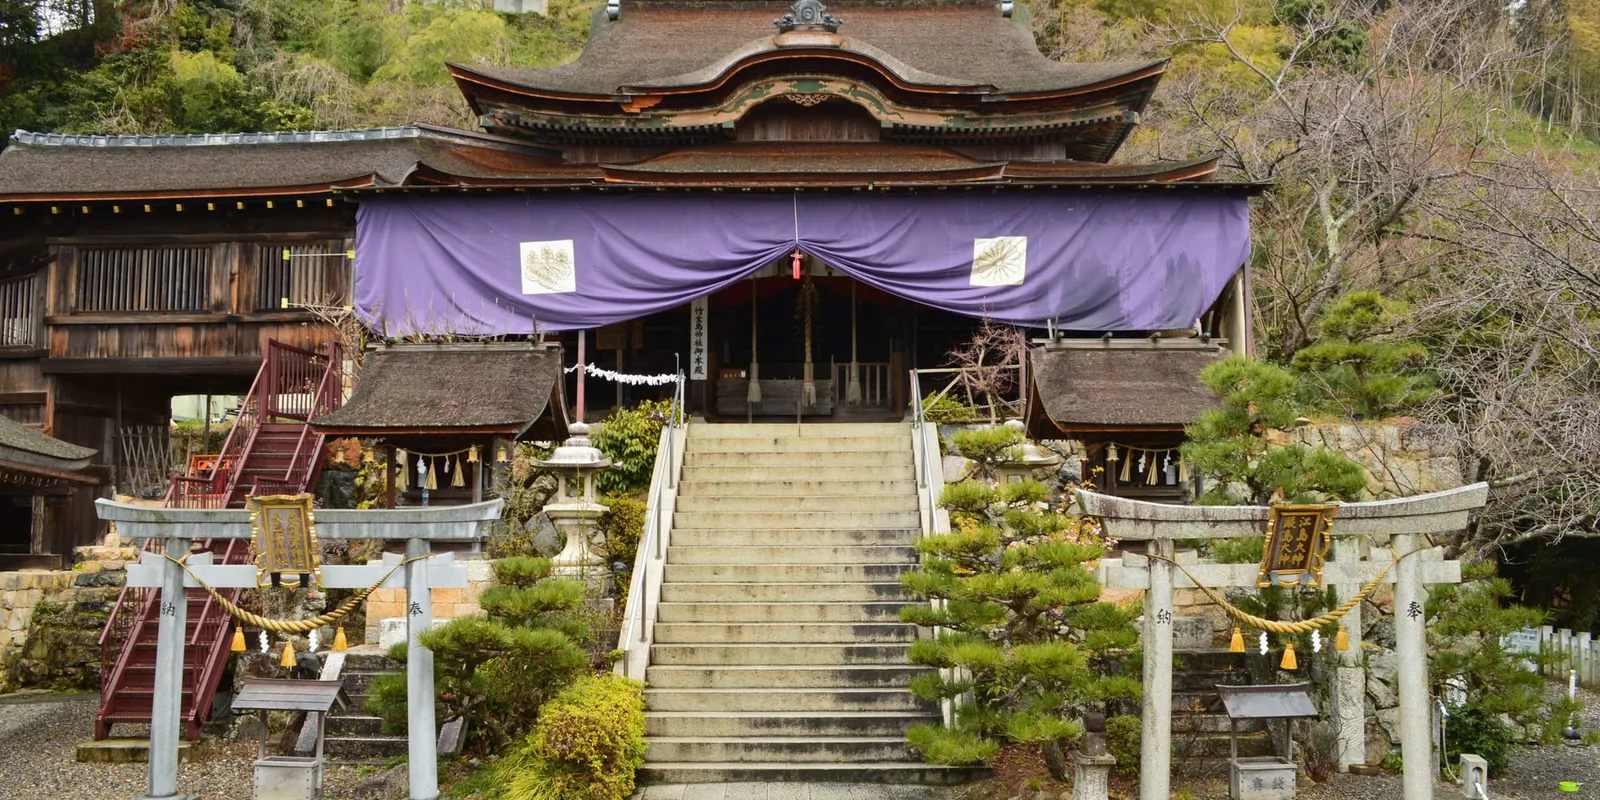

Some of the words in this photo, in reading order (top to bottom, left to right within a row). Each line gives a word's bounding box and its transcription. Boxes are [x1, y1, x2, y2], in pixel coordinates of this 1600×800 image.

[161, 602, 176, 617] 納
[409, 601, 423, 617] 奉
[1157, 608, 1172, 625] 納
[1406, 601, 1422, 622] 奉
